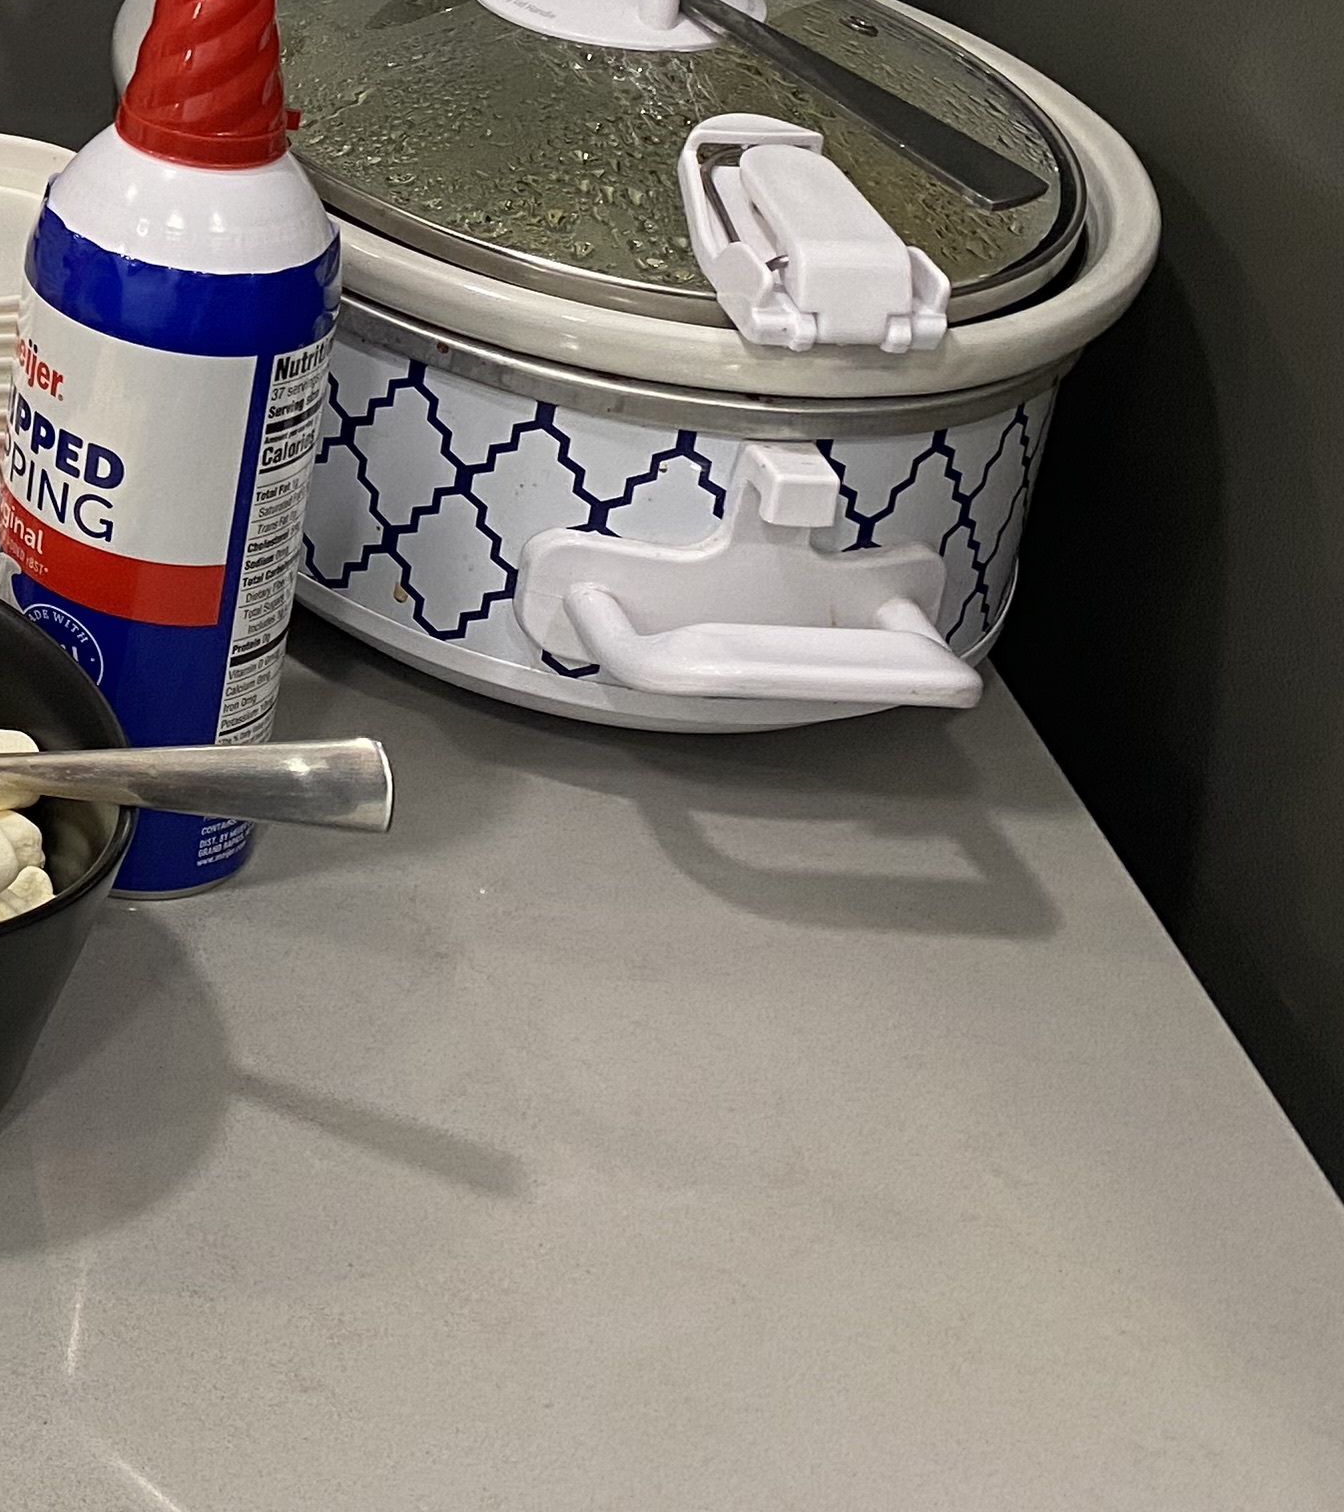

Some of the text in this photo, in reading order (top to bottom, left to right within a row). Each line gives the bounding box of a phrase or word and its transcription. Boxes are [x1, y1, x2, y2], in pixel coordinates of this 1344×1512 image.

[15, 338, 64, 400] eijer
[272, 385, 286, 401] 37
[268, 400, 305, 419] Serving
[9, 383, 125, 490] IPPED
[5, 426, 114, 543] PING
[256, 484, 278, 502] Total
[278, 481, 291, 497] Fat
[1, 501, 43, 555] ginal
[243, 571, 265, 588] Total
[244, 603, 263, 620] Total
[52, 611, 89, 644] WITH
[232, 637, 261, 655] Protein
[223, 693, 257, 714] Iron 0mg
[219, 831, 229, 843] BY
